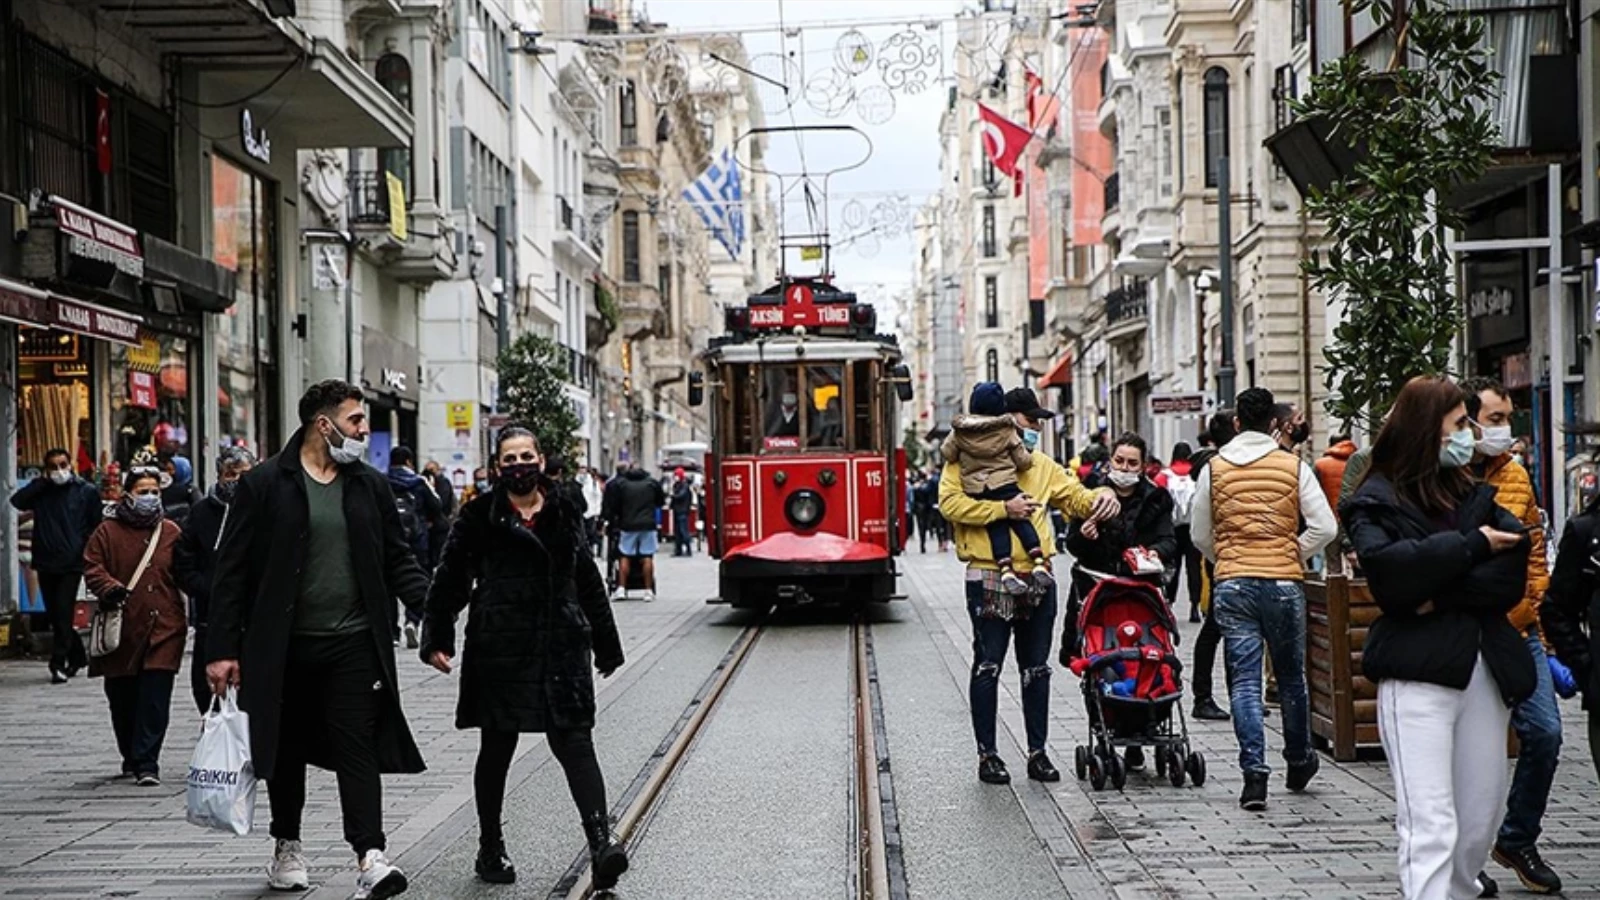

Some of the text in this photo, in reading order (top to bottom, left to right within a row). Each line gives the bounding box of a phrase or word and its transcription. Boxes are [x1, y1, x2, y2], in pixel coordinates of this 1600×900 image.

[793, 287, 803, 304] 4
[726, 474, 743, 491] 115
[865, 470, 882, 487] 115
